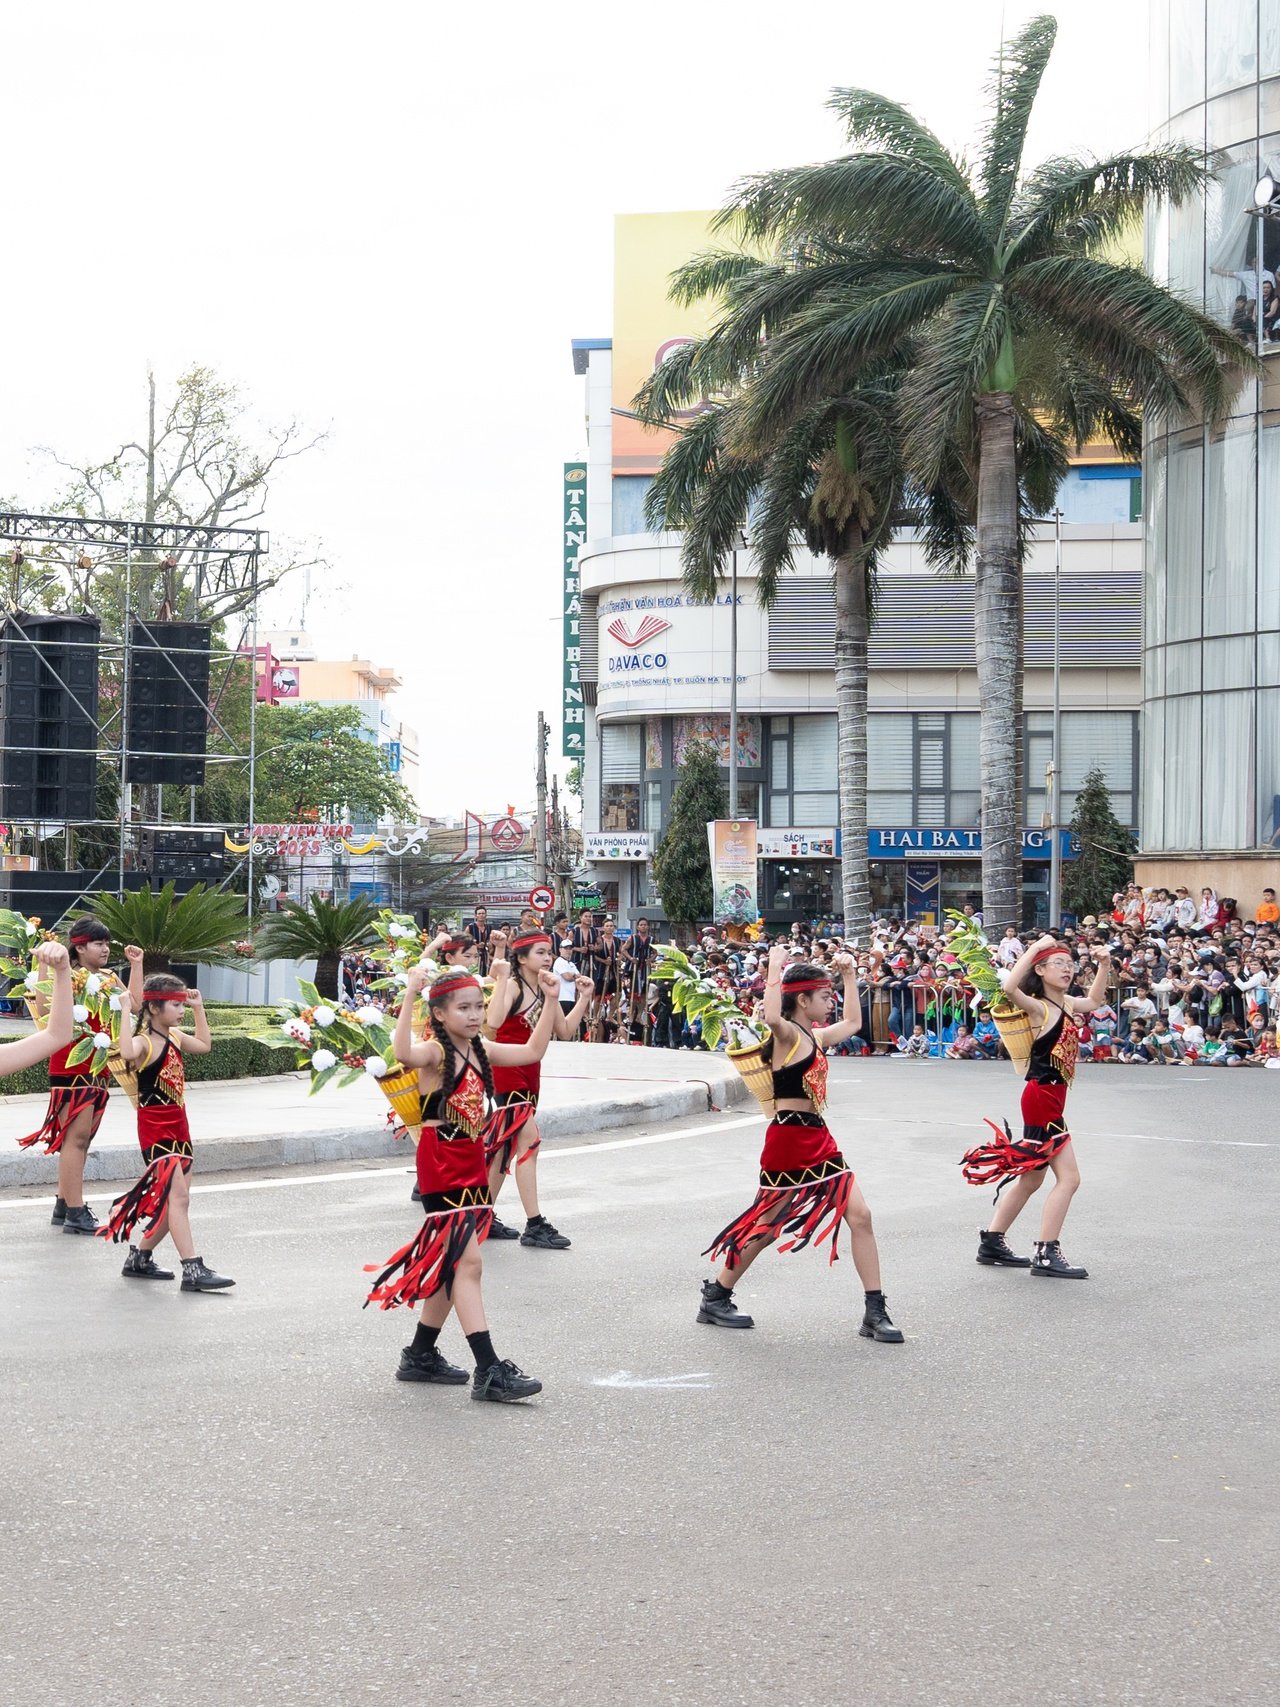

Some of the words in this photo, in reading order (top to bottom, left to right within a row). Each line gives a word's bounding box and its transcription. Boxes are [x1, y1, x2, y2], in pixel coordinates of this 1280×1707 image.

[634, 596, 654, 609] VĂN
[608, 653, 667, 672] DAVACO
[288, 824, 318, 837] NEW
[322, 824, 354, 838] YEAR
[784, 832, 804, 842] SÁCH
[588, 836, 602, 846] VĂN
[604, 836, 628, 846] PHÒNG
[879, 830, 926, 847] HAI
[932, 831, 958, 847] BA
[276, 840, 321, 856] 2025
